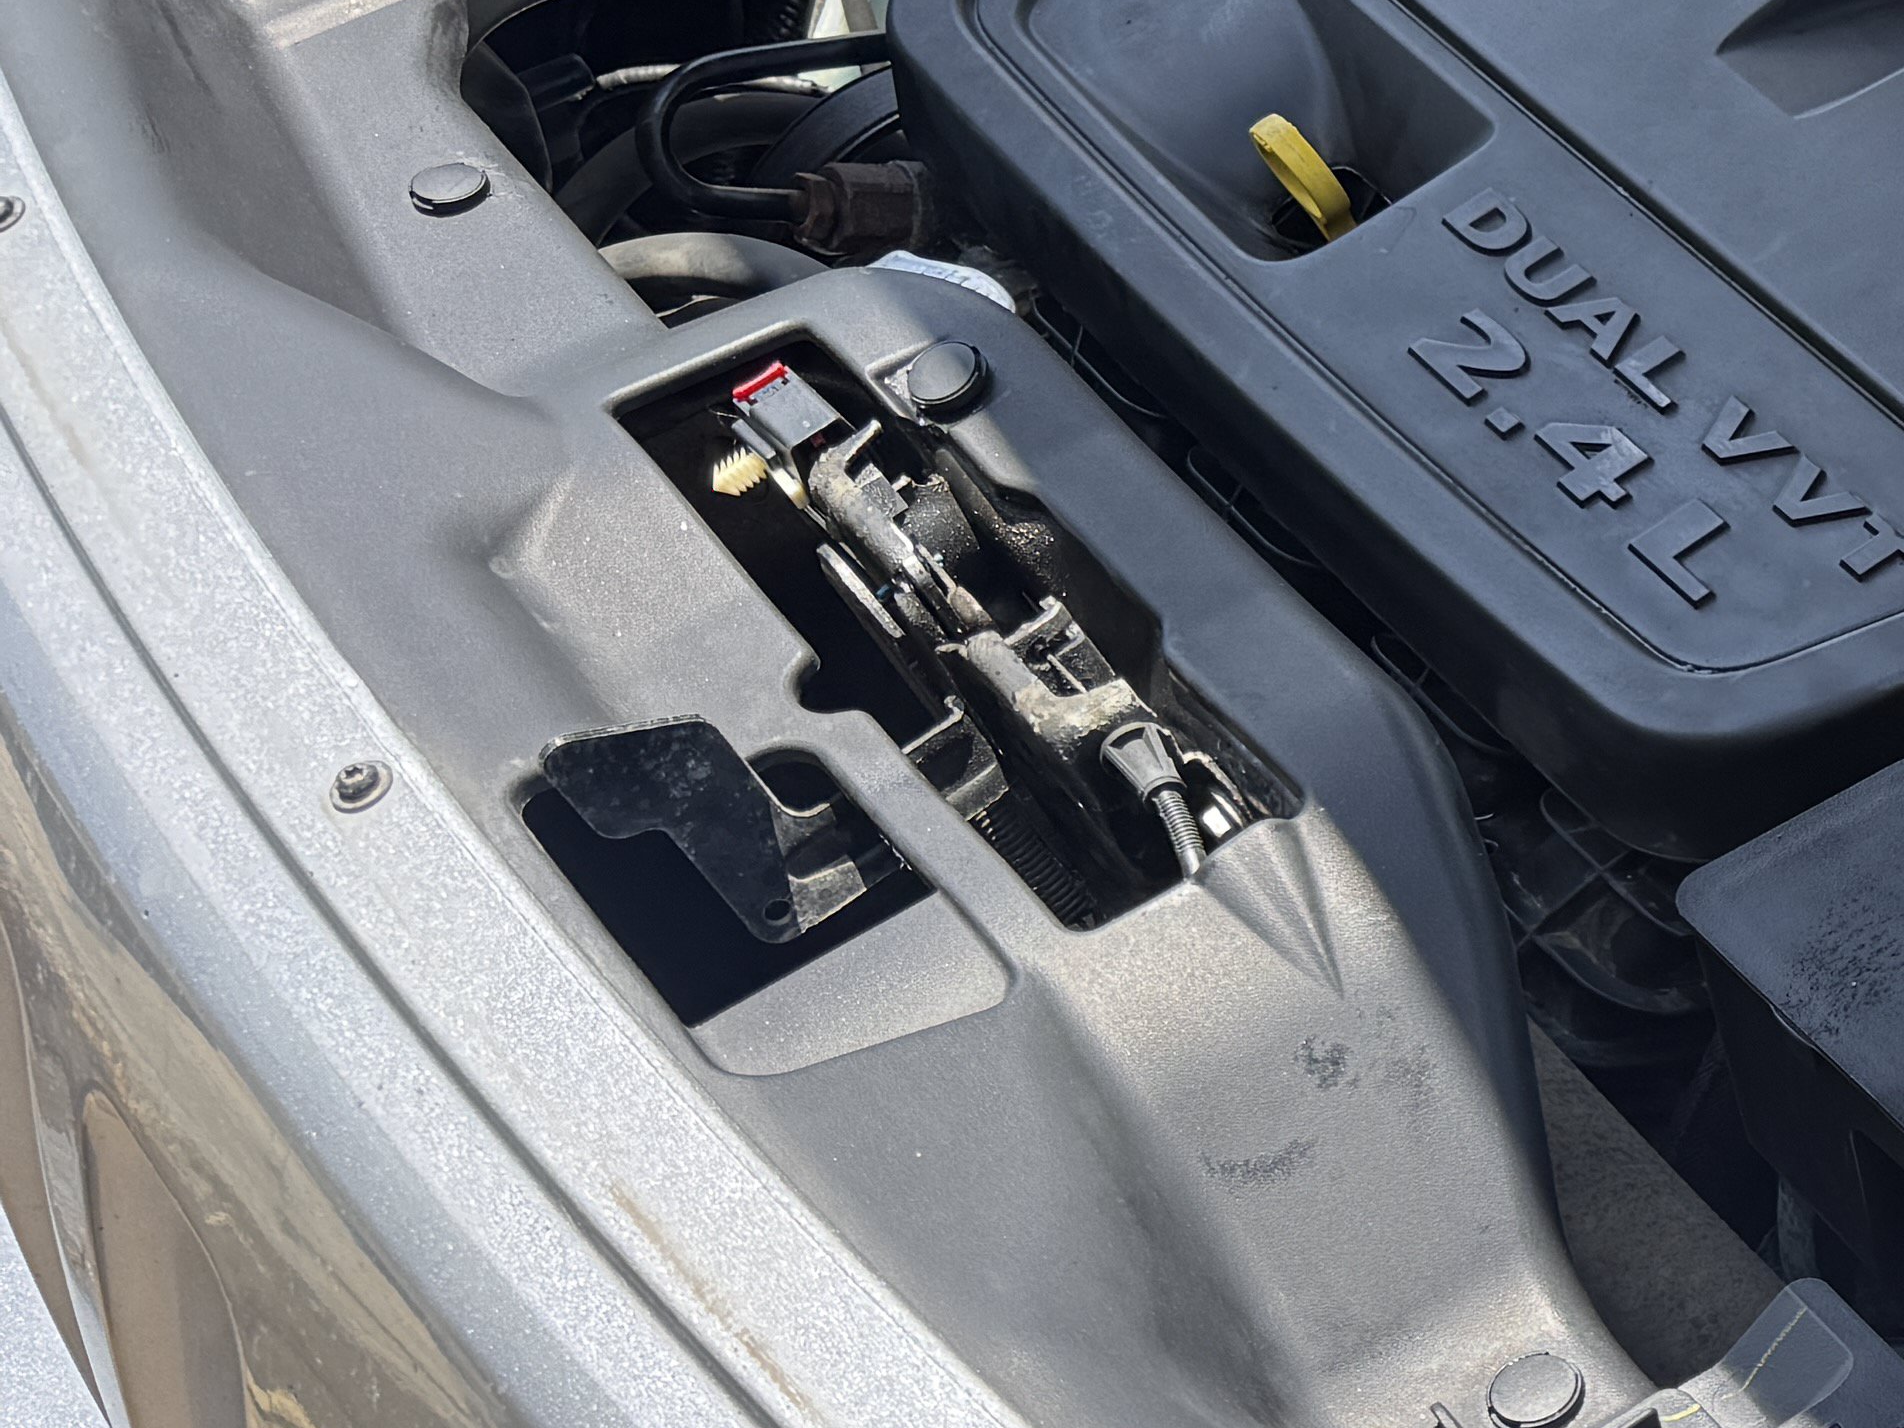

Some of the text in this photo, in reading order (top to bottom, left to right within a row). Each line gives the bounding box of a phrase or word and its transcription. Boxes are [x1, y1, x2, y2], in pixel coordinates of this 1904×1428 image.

[1441, 185, 1687, 416] DUAL
[1405, 308, 1732, 609] 2.4 L
